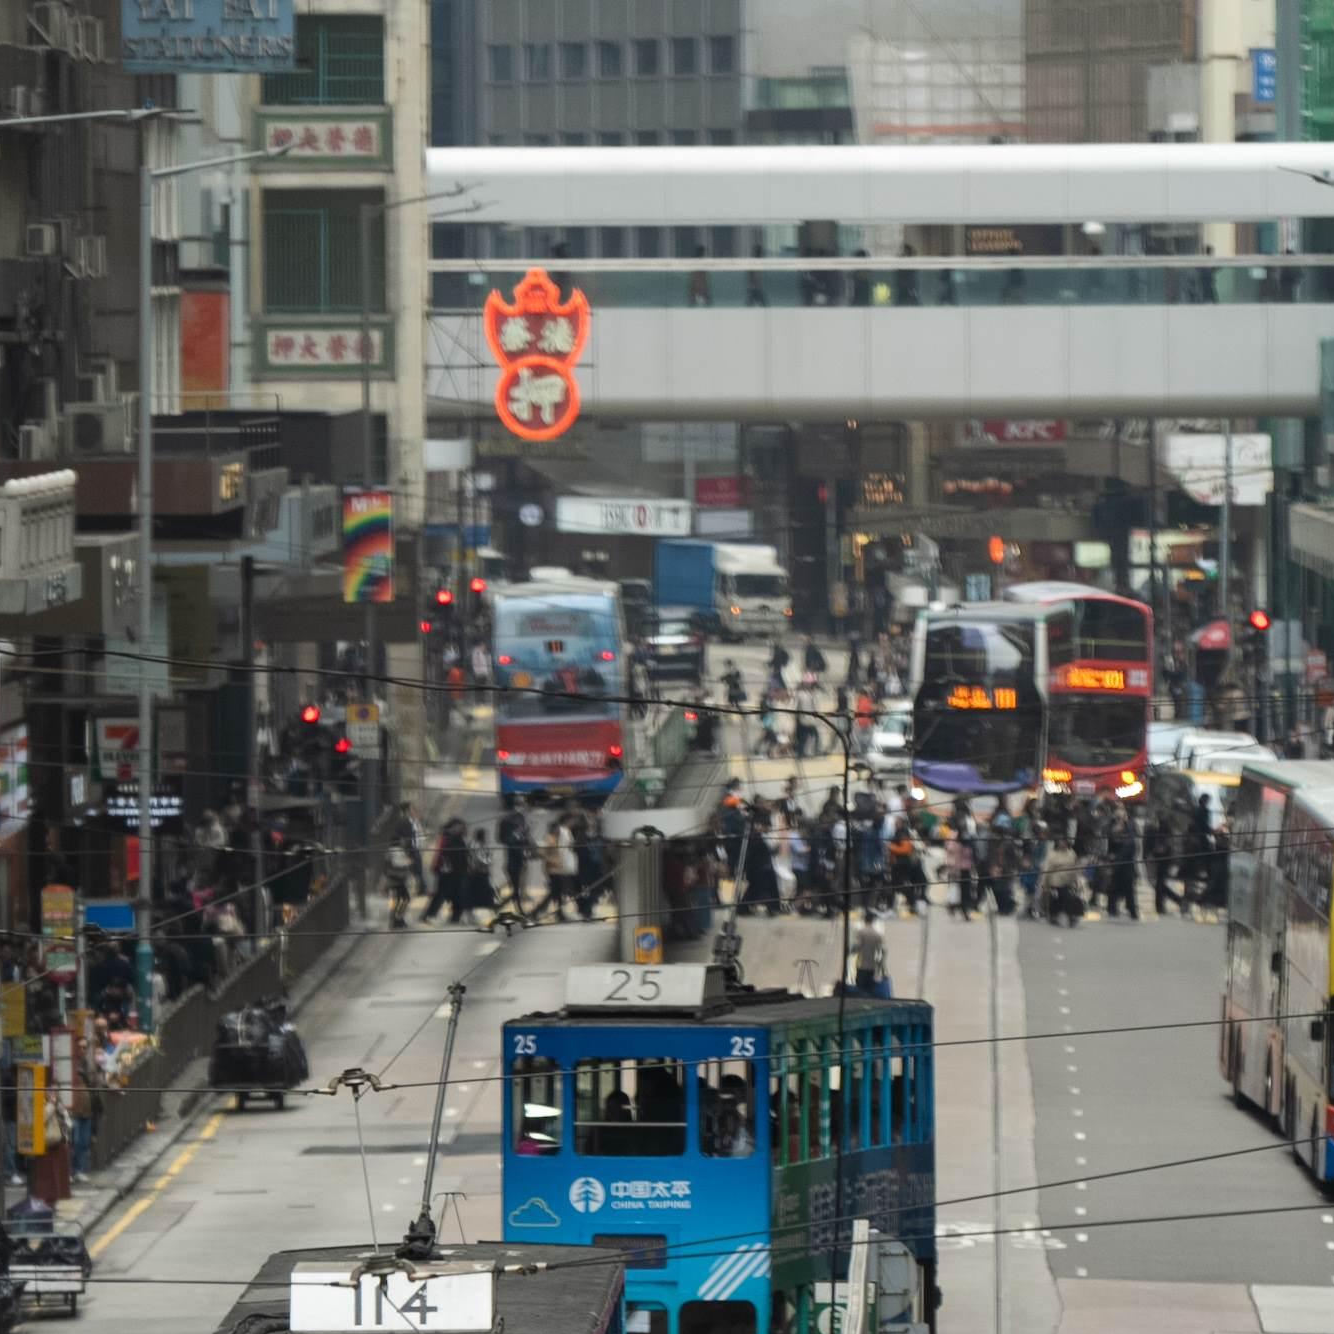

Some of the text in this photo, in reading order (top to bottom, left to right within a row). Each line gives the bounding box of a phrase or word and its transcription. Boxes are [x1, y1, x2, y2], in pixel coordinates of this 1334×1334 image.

[604, 969, 663, 1001] 25
[514, 1034, 537, 1055] 25
[730, 1036, 756, 1057] 25
[610, 1180, 692, 1199] 中国太平
[611, 1200, 692, 1210] CHINA TAIPING
[353, 1278, 438, 1326] 114
